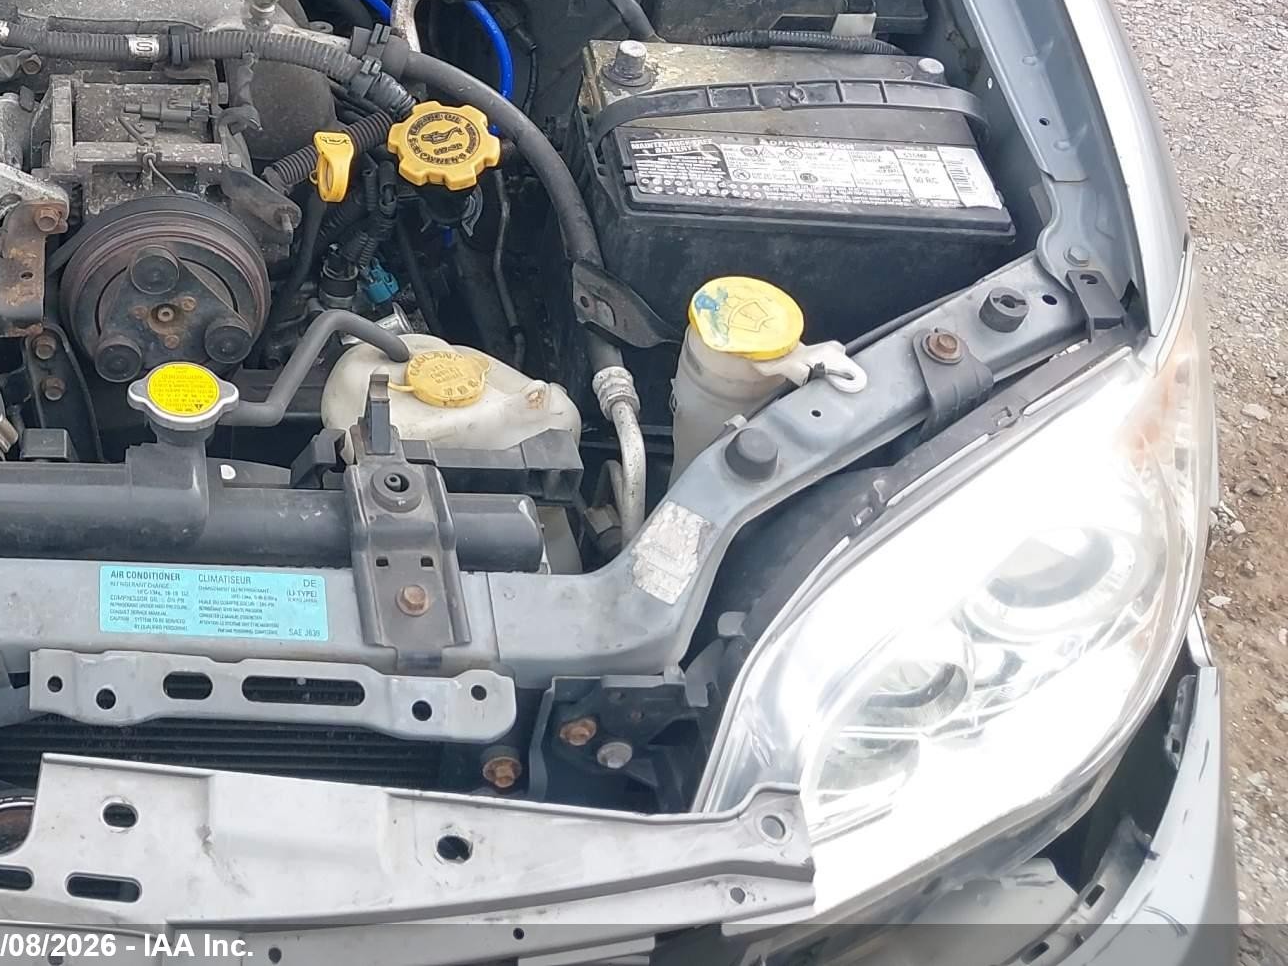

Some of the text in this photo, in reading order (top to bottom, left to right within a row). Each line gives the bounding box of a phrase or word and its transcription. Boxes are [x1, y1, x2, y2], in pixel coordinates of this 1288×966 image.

[136, 41, 153, 52] S
[110, 570, 180, 581] AIR CONDITIONER
[198, 574, 251, 585] CLIMATISEUR
[303, 579, 317, 588] DE
